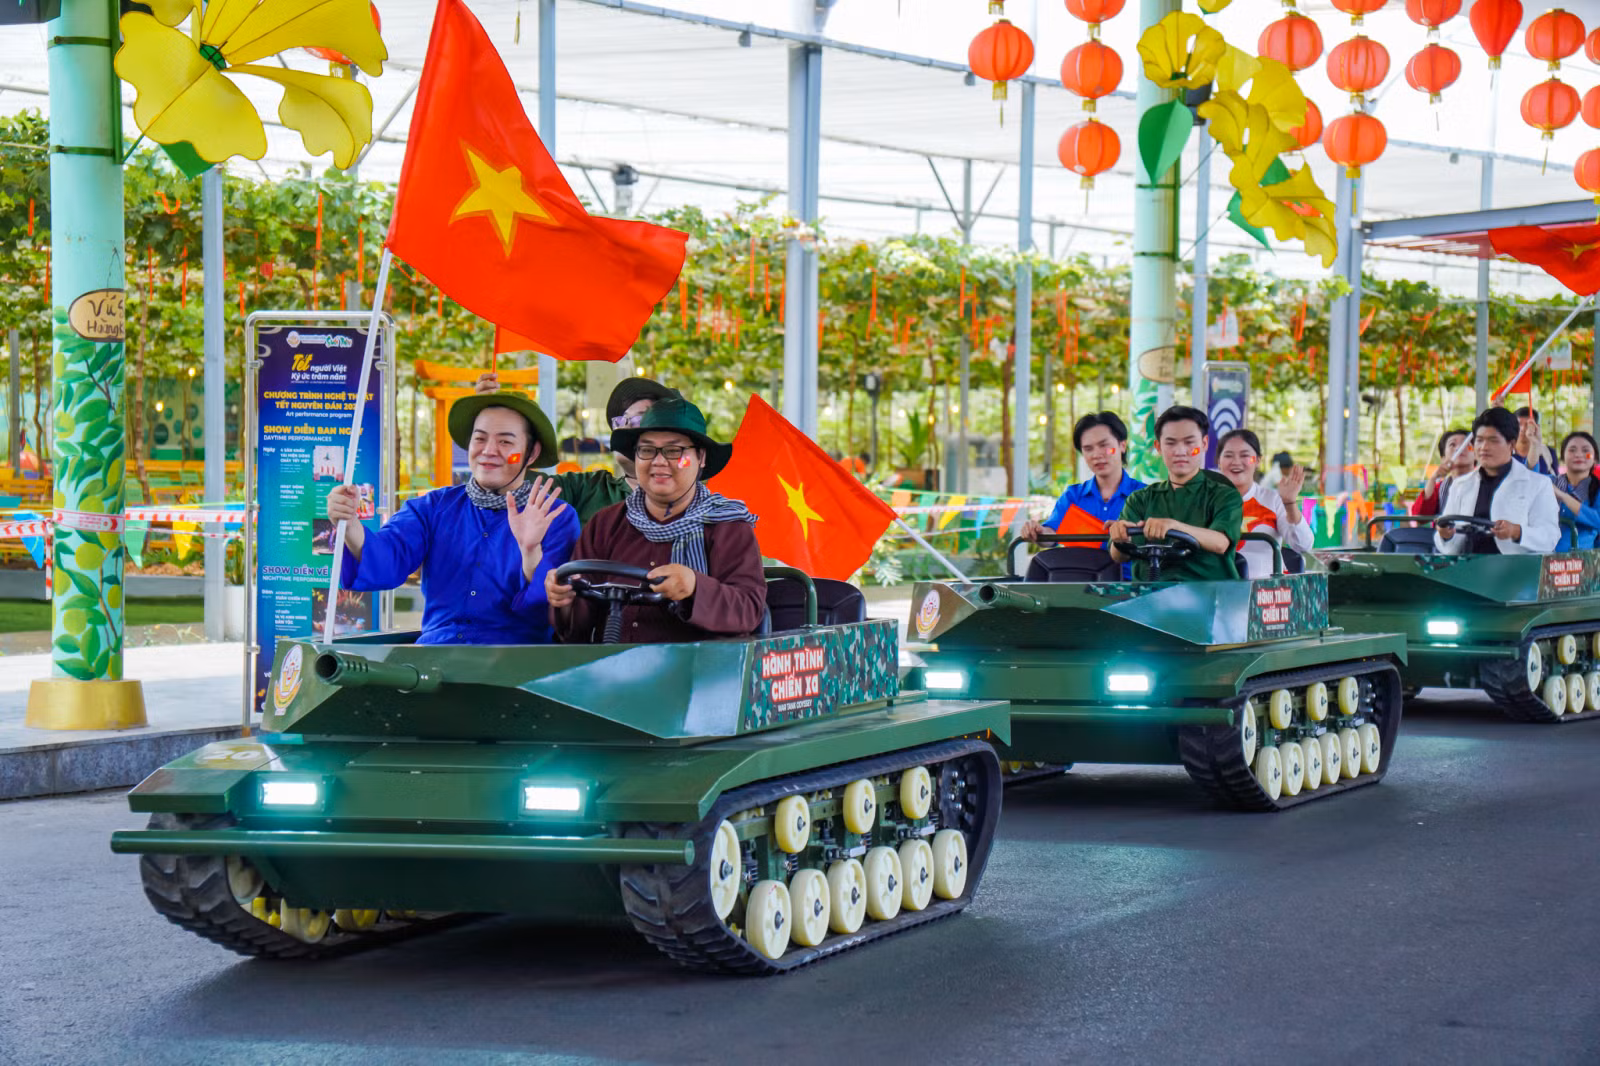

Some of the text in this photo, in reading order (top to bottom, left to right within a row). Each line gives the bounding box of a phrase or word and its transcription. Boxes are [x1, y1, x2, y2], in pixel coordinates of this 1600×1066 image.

[292, 354, 348, 373] Tết người Việt
[299, 391, 323, 400] TRÌNH
[324, 392, 347, 401] NGHỆ
[275, 400, 290, 409] TẾT
[291, 402, 323, 410] NGUYÊN
[324, 402, 343, 410] ĐÁN
[263, 426, 292, 434] SHOW
[293, 423, 315, 435] DIỄN
[317, 427, 337, 435] BAN
[262, 566, 291, 575] SHOW
[293, 564, 315, 576] DIỄN
[794, 648, 824, 671] TRÌNH
[771, 666, 802, 701] CHIẾN
